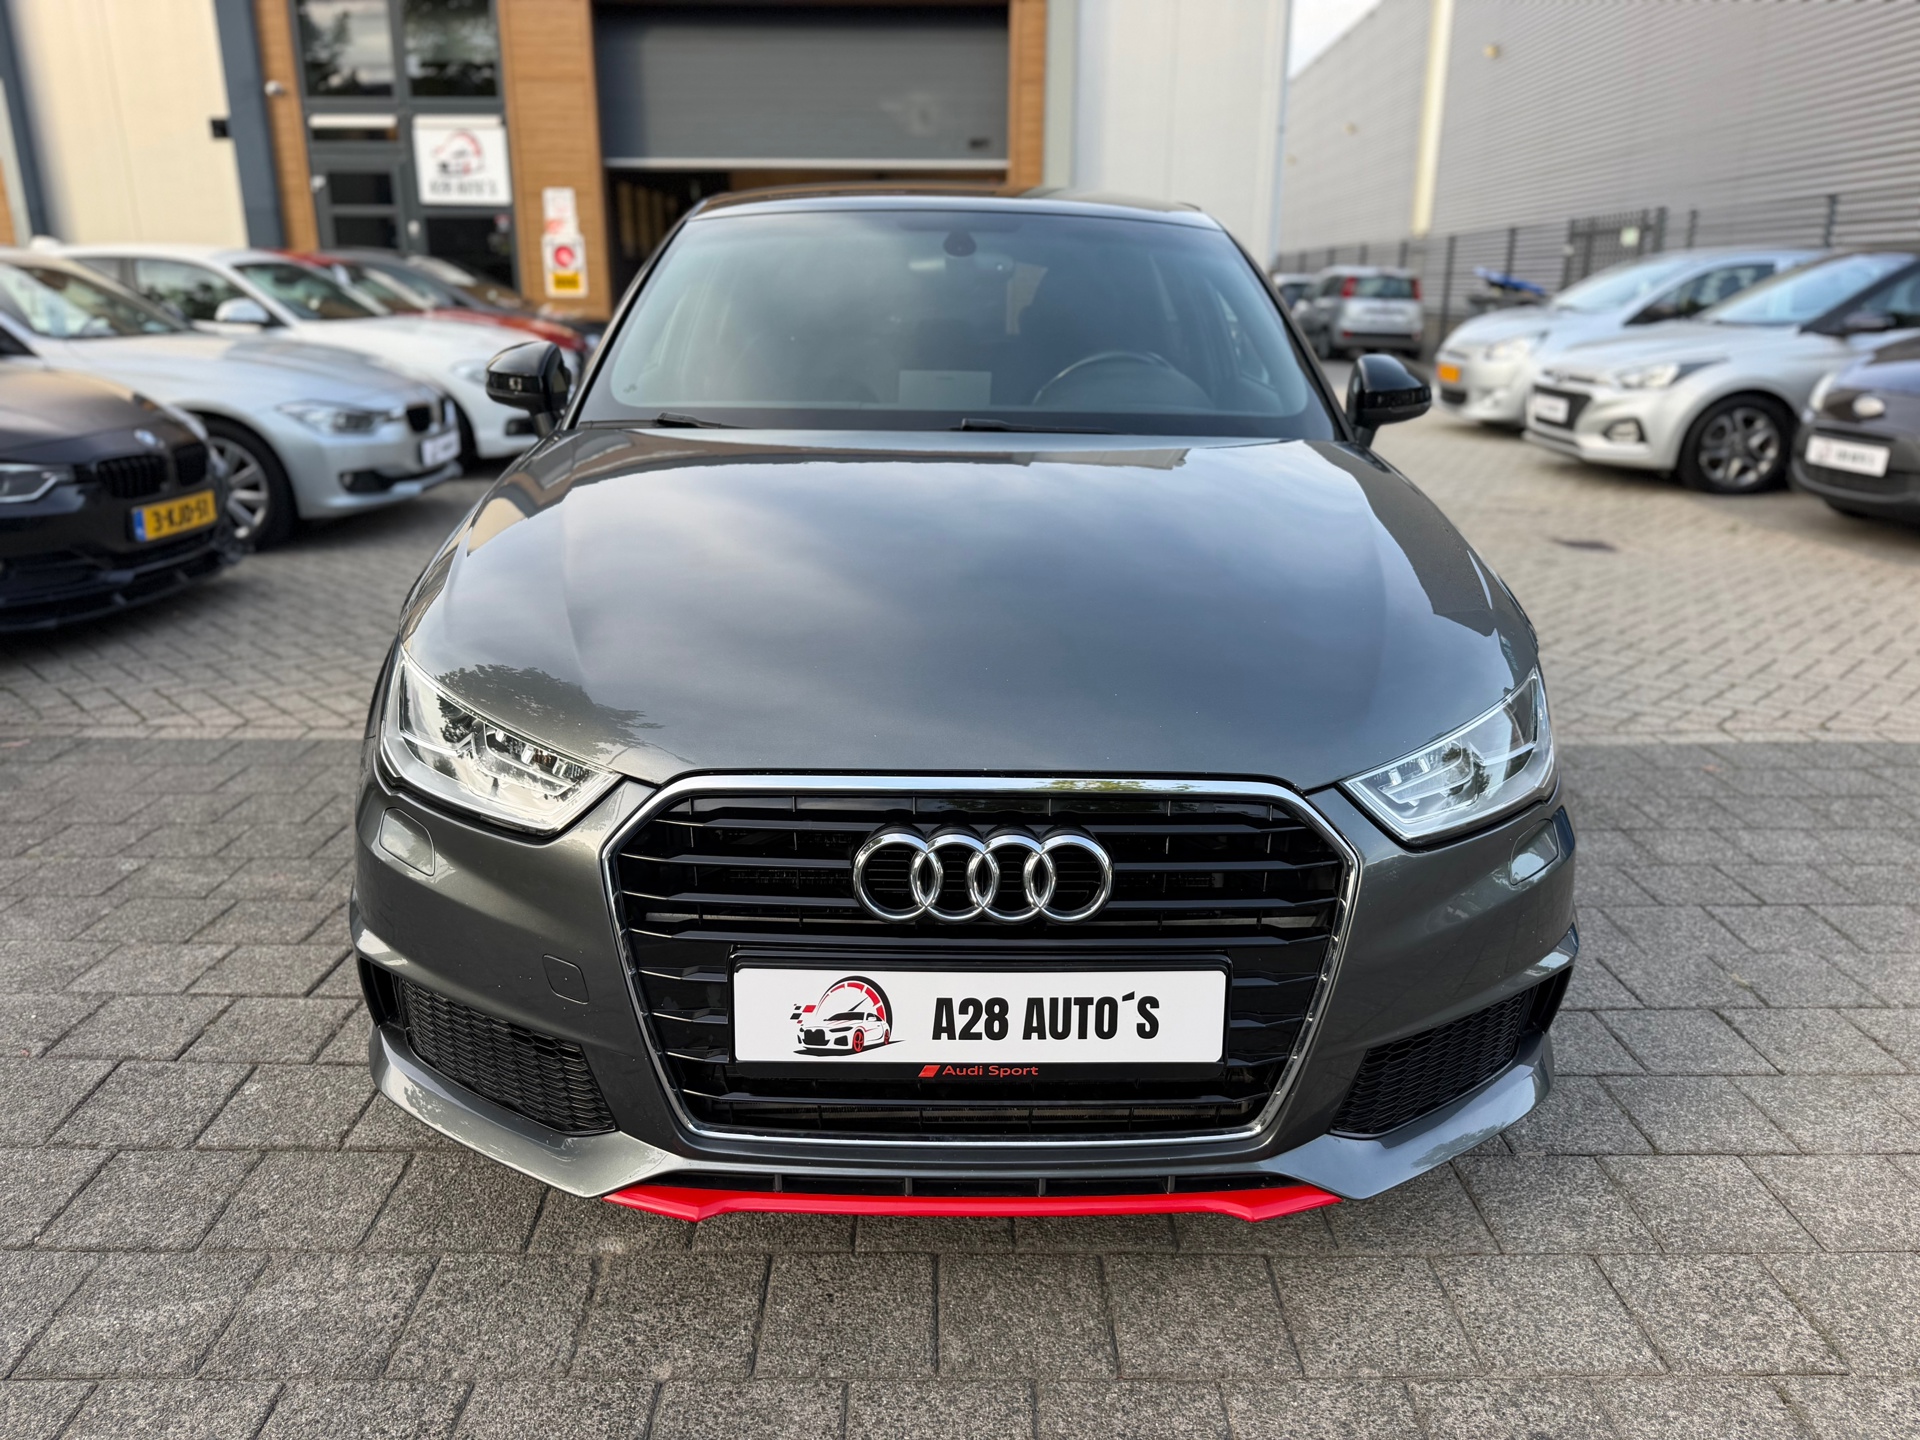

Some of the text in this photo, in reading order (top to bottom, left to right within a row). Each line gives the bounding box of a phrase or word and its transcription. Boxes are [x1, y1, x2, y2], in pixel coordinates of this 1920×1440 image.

[931, 997, 1009, 1041] A28
[942, 1065, 1039, 1078] Audi Sport
